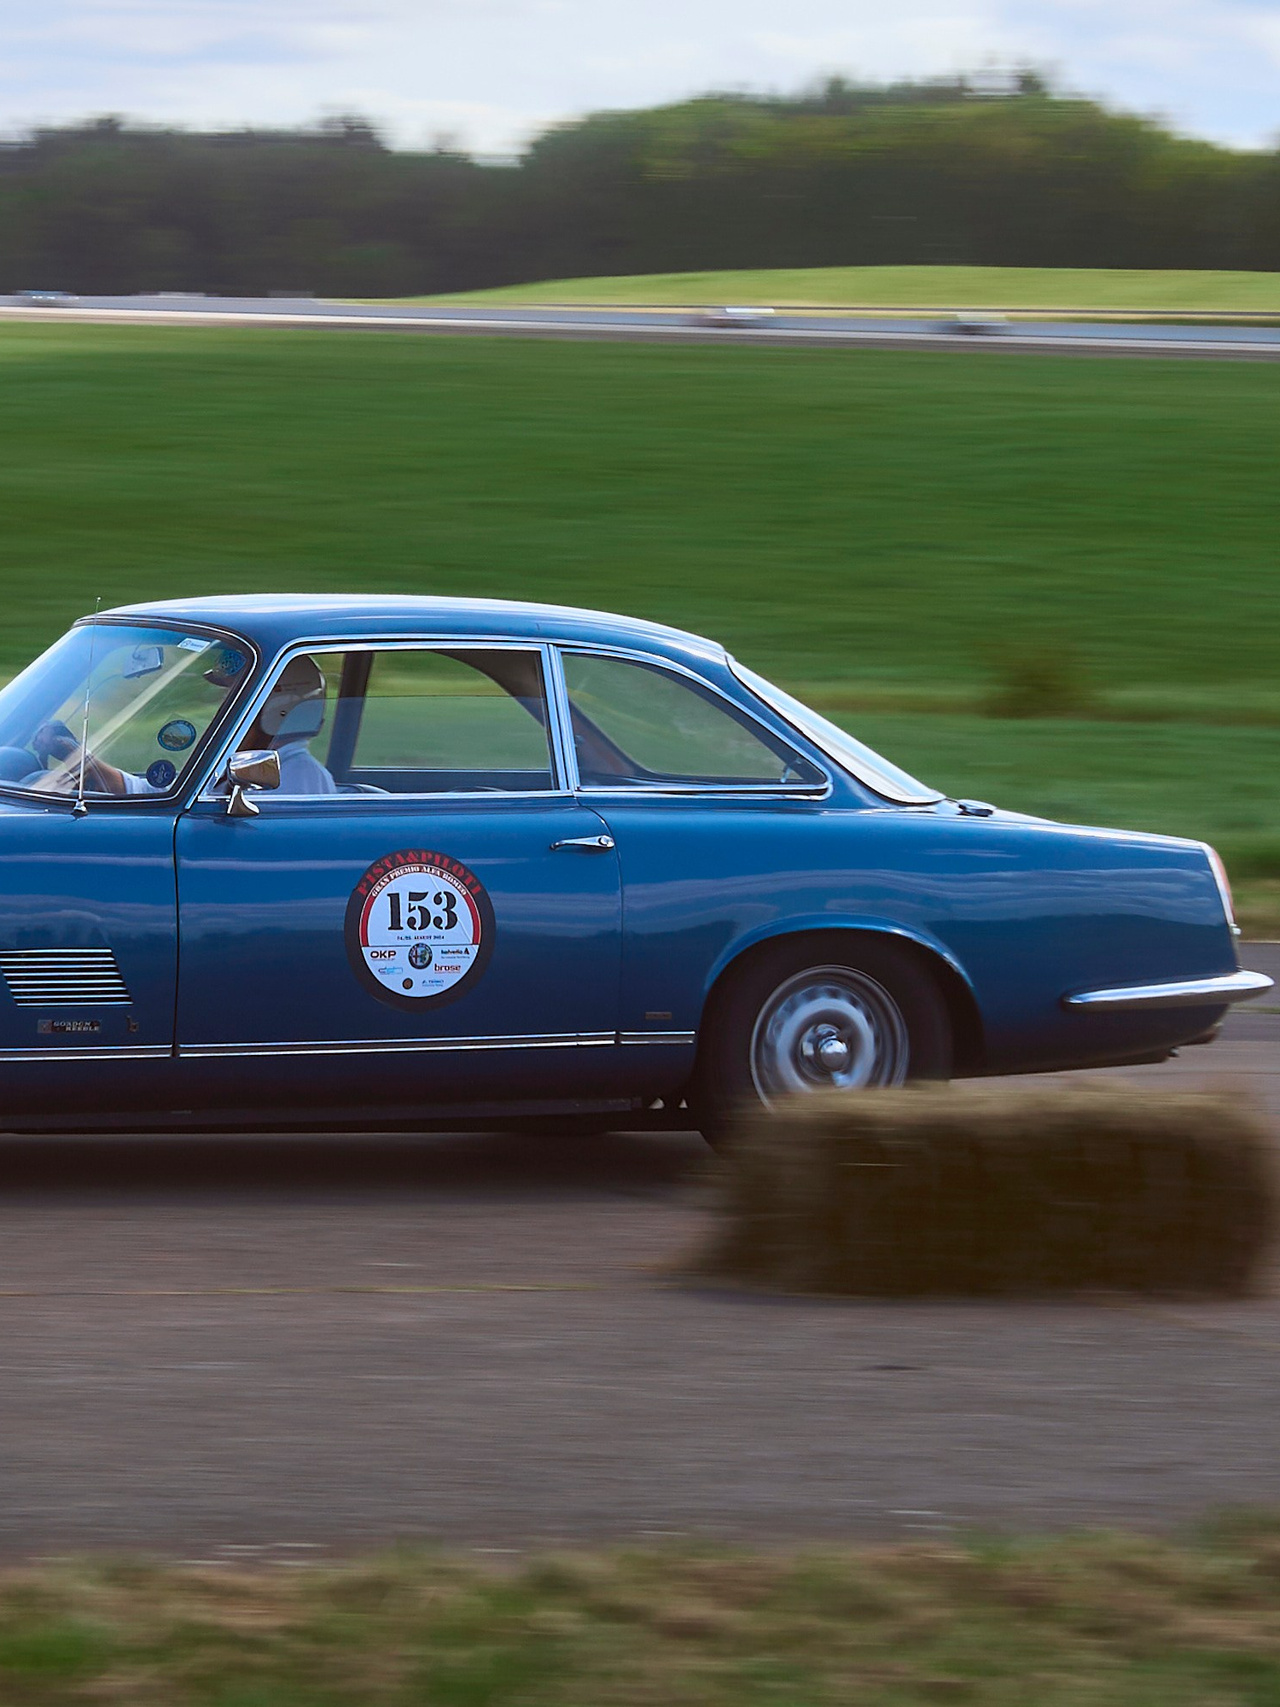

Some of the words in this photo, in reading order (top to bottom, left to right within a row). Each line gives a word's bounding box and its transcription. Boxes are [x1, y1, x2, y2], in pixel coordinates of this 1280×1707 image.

[371, 877, 390, 897] GRAN
[389, 866, 420, 880] PREMIO
[421, 866, 441, 876] ALFA
[442, 873, 467, 896] ROMEO
[387, 891, 458, 931] 153
[370, 950, 397, 959] OKP
[434, 963, 461, 972] brose
